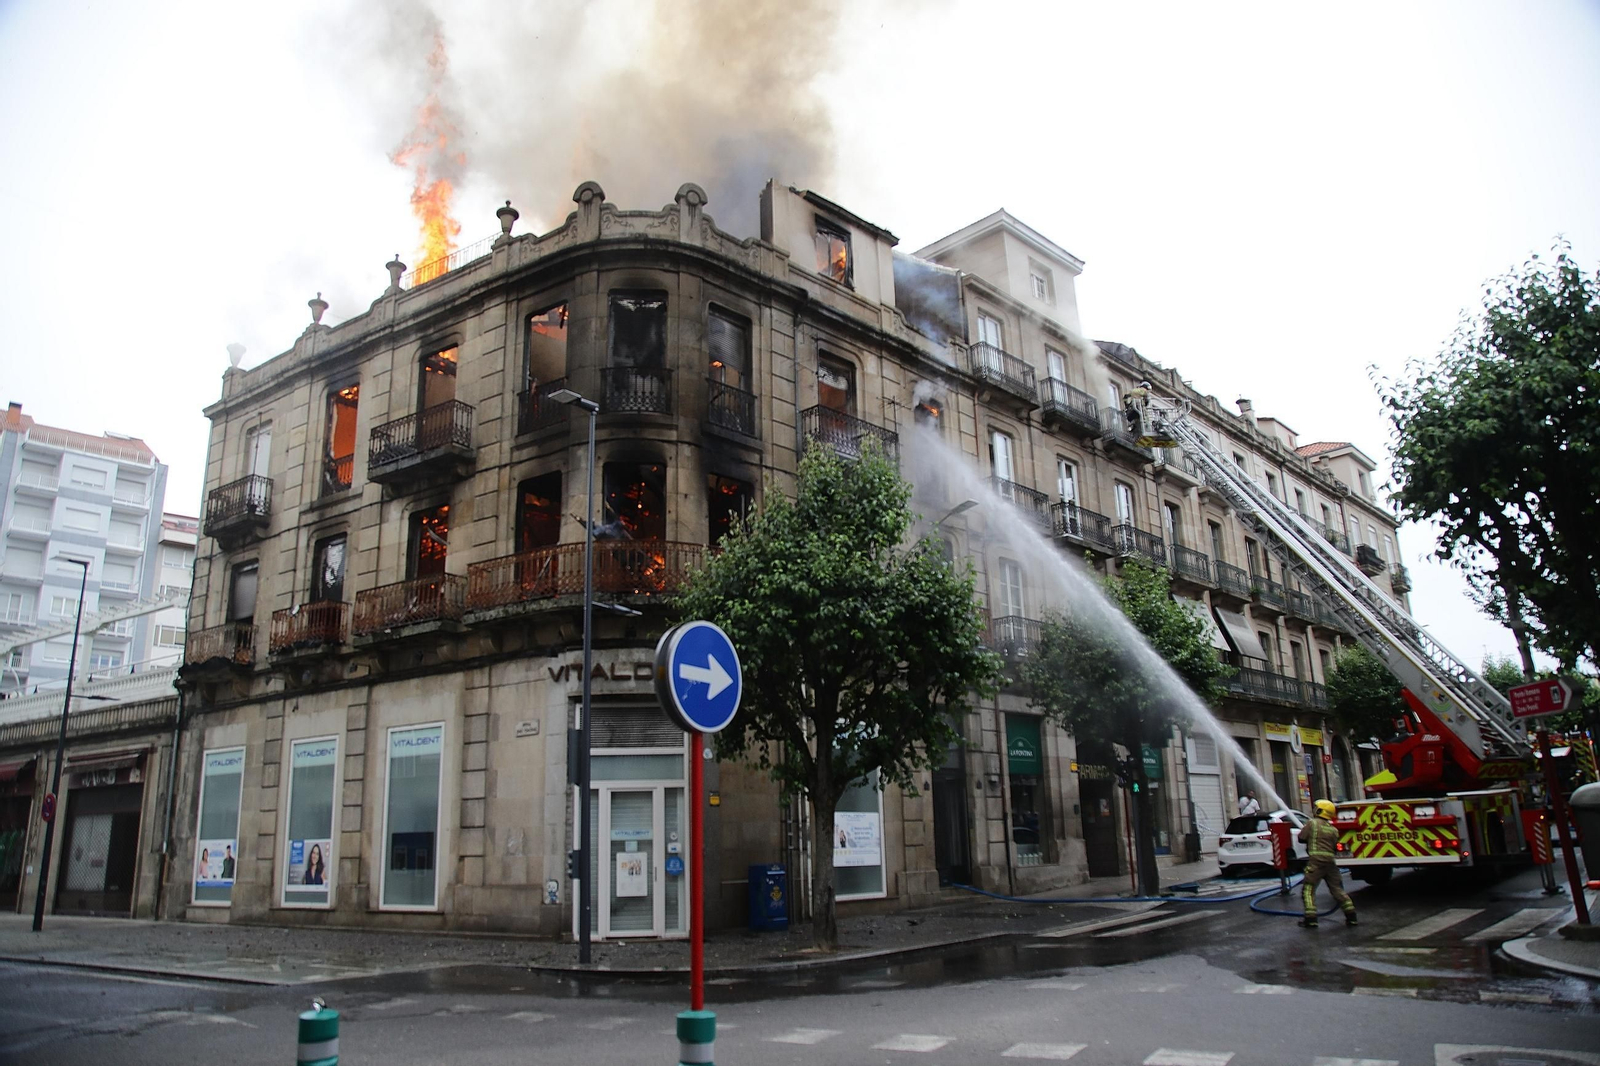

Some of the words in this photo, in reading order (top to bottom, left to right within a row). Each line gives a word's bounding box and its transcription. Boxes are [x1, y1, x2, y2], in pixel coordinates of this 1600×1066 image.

[393, 735, 440, 747] VITALDENT
[296, 747, 336, 758] VITALDENT
[209, 757, 242, 767] VITALDENT
[1378, 811, 1399, 824] 112
[1356, 829, 1419, 842] BOMBEIROS
